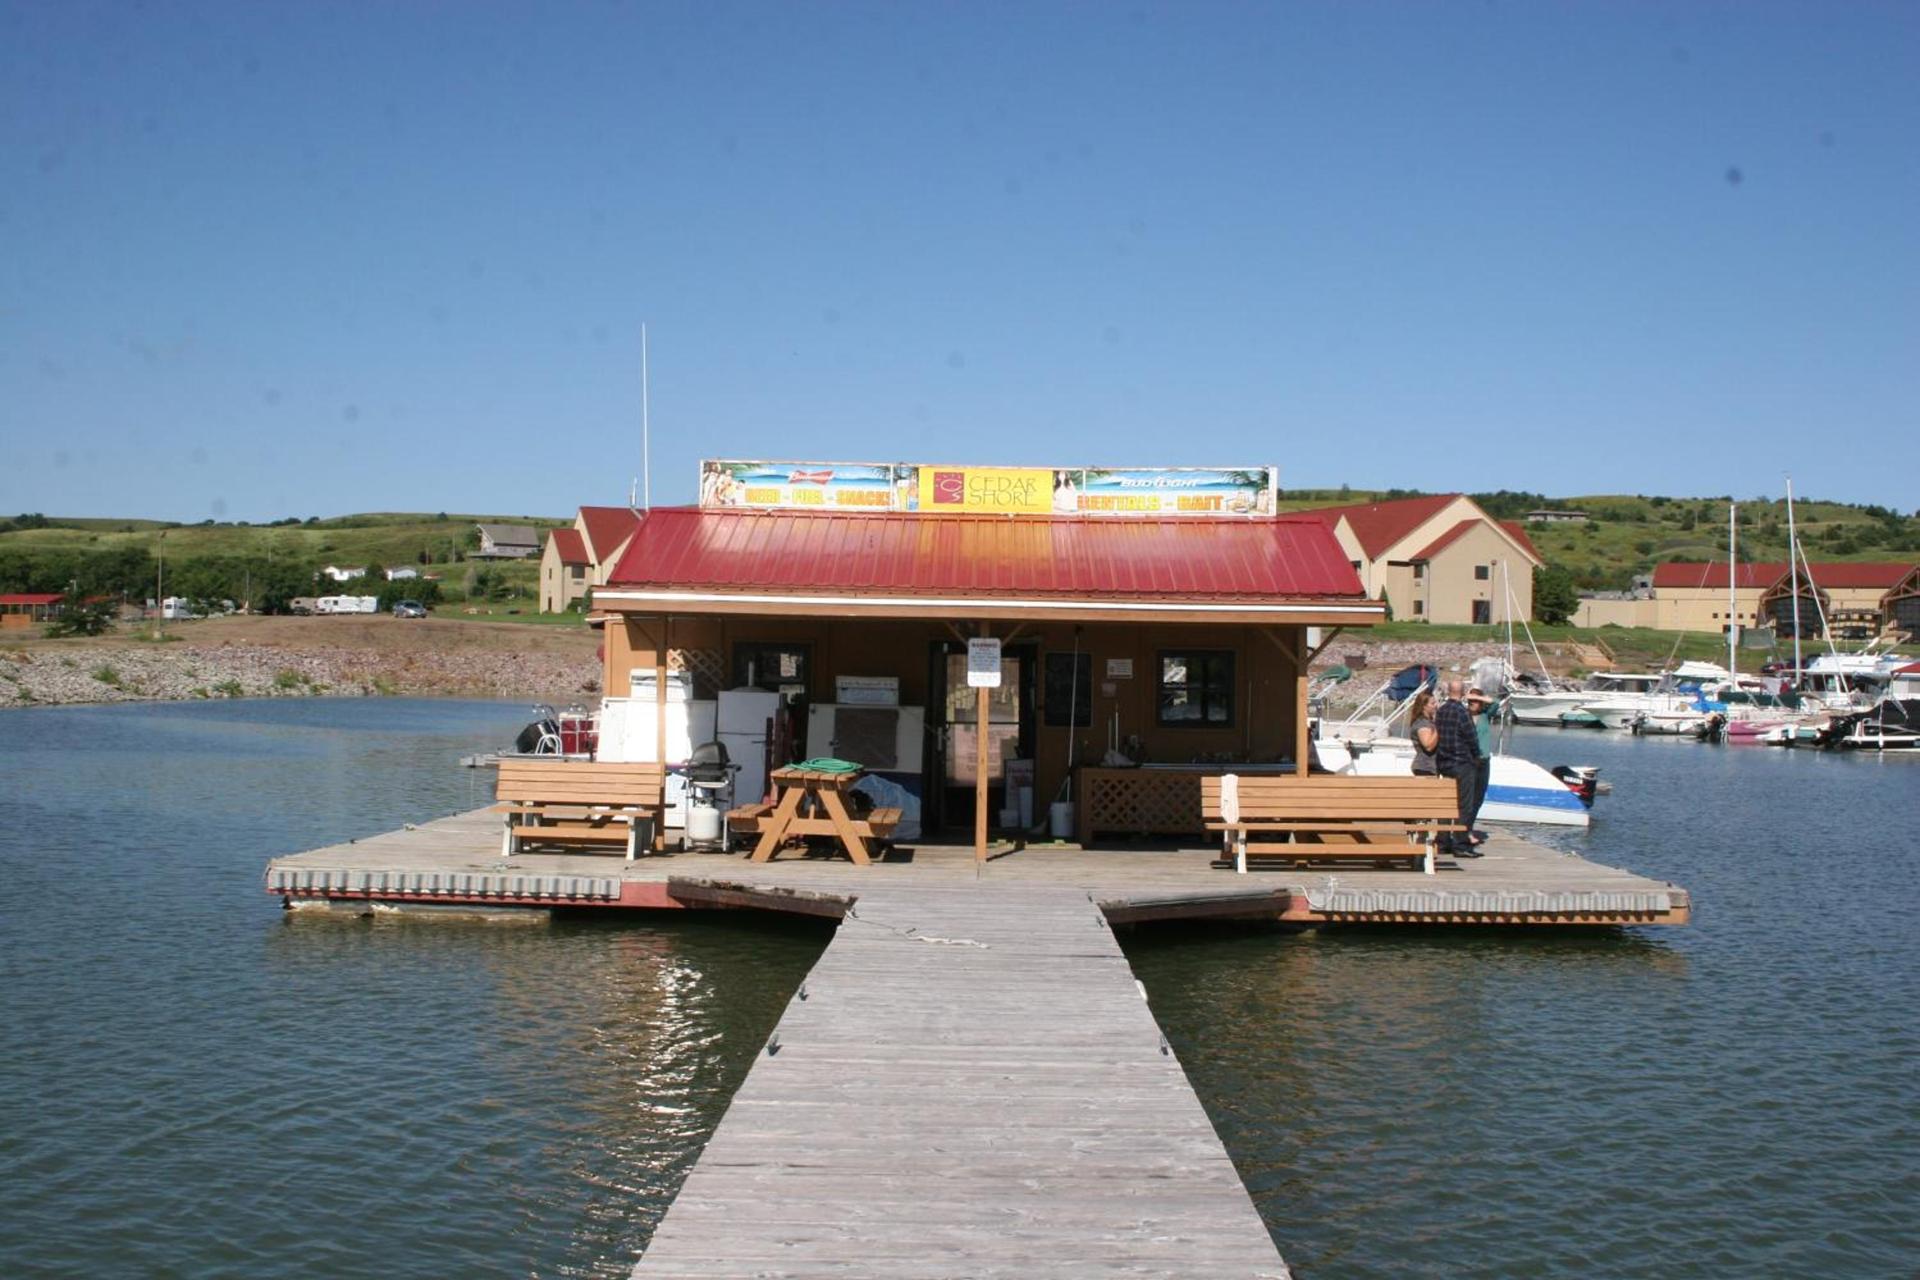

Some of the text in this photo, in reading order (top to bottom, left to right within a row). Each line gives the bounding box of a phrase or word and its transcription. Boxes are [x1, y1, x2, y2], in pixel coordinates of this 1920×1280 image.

[968, 476, 1037, 492] CEDAR
[968, 490, 1040, 506] SHORE
[1077, 495, 1224, 511] RENTALS BAIT
